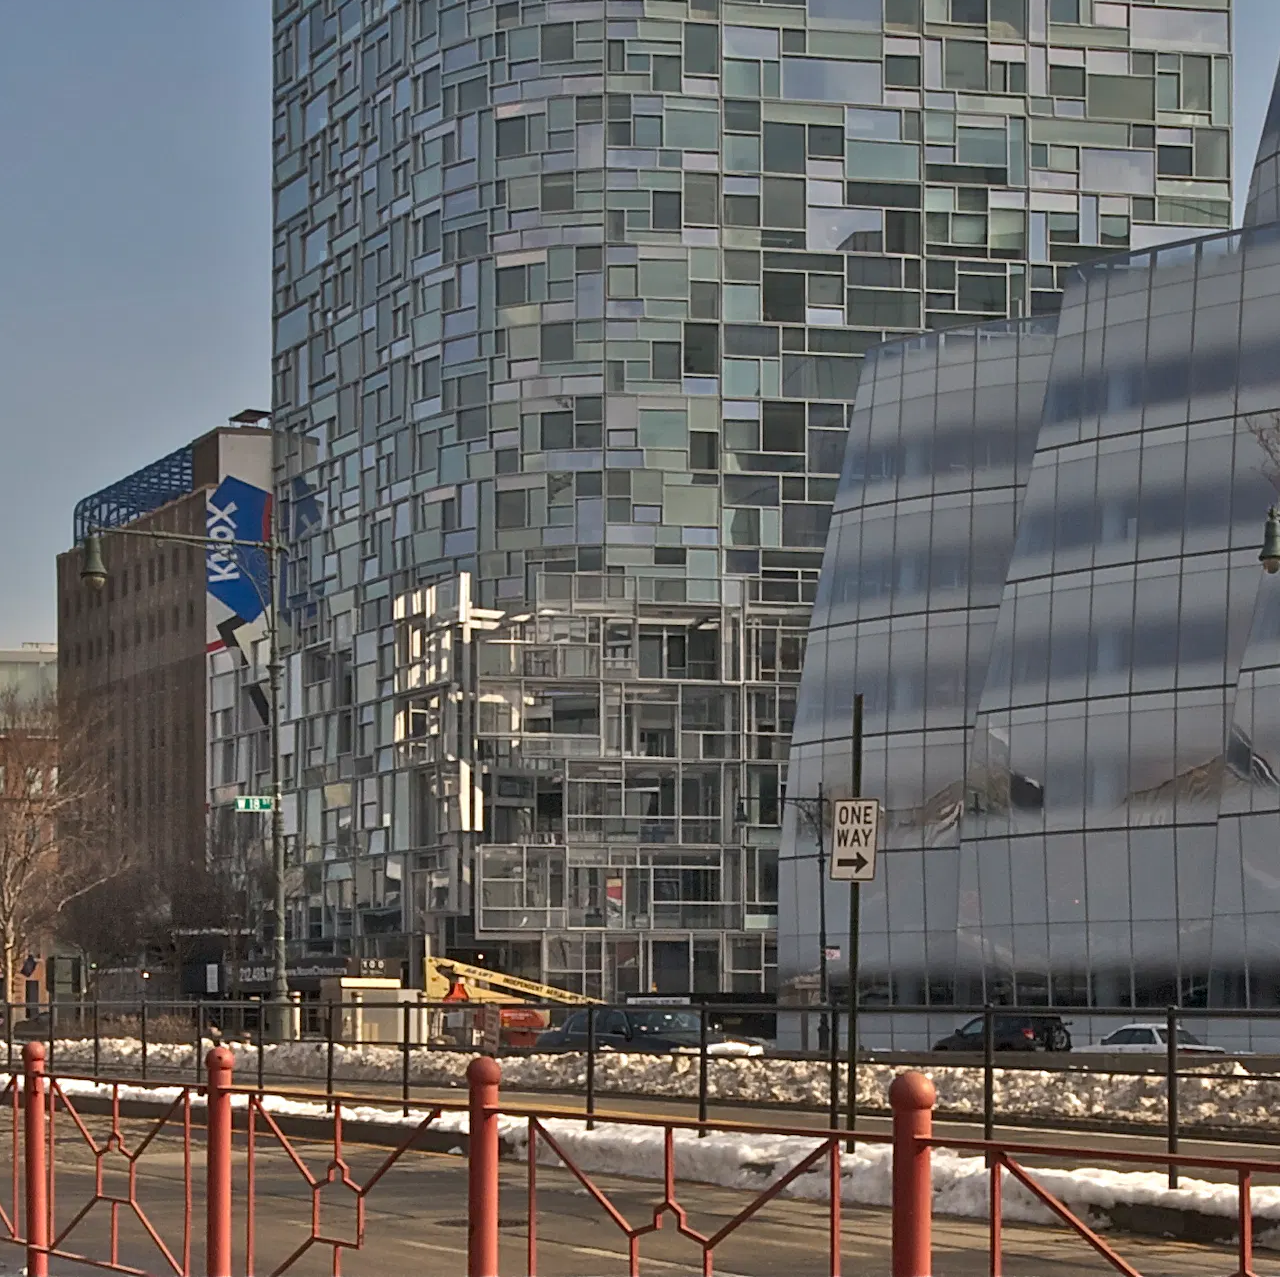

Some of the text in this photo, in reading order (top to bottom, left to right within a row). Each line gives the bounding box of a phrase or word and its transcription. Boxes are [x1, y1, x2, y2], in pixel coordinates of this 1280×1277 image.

[237, 798, 246, 810] W
[249, 797, 261, 810] 18
[838, 805, 873, 825] ONE
[837, 828, 873, 848] WAY
